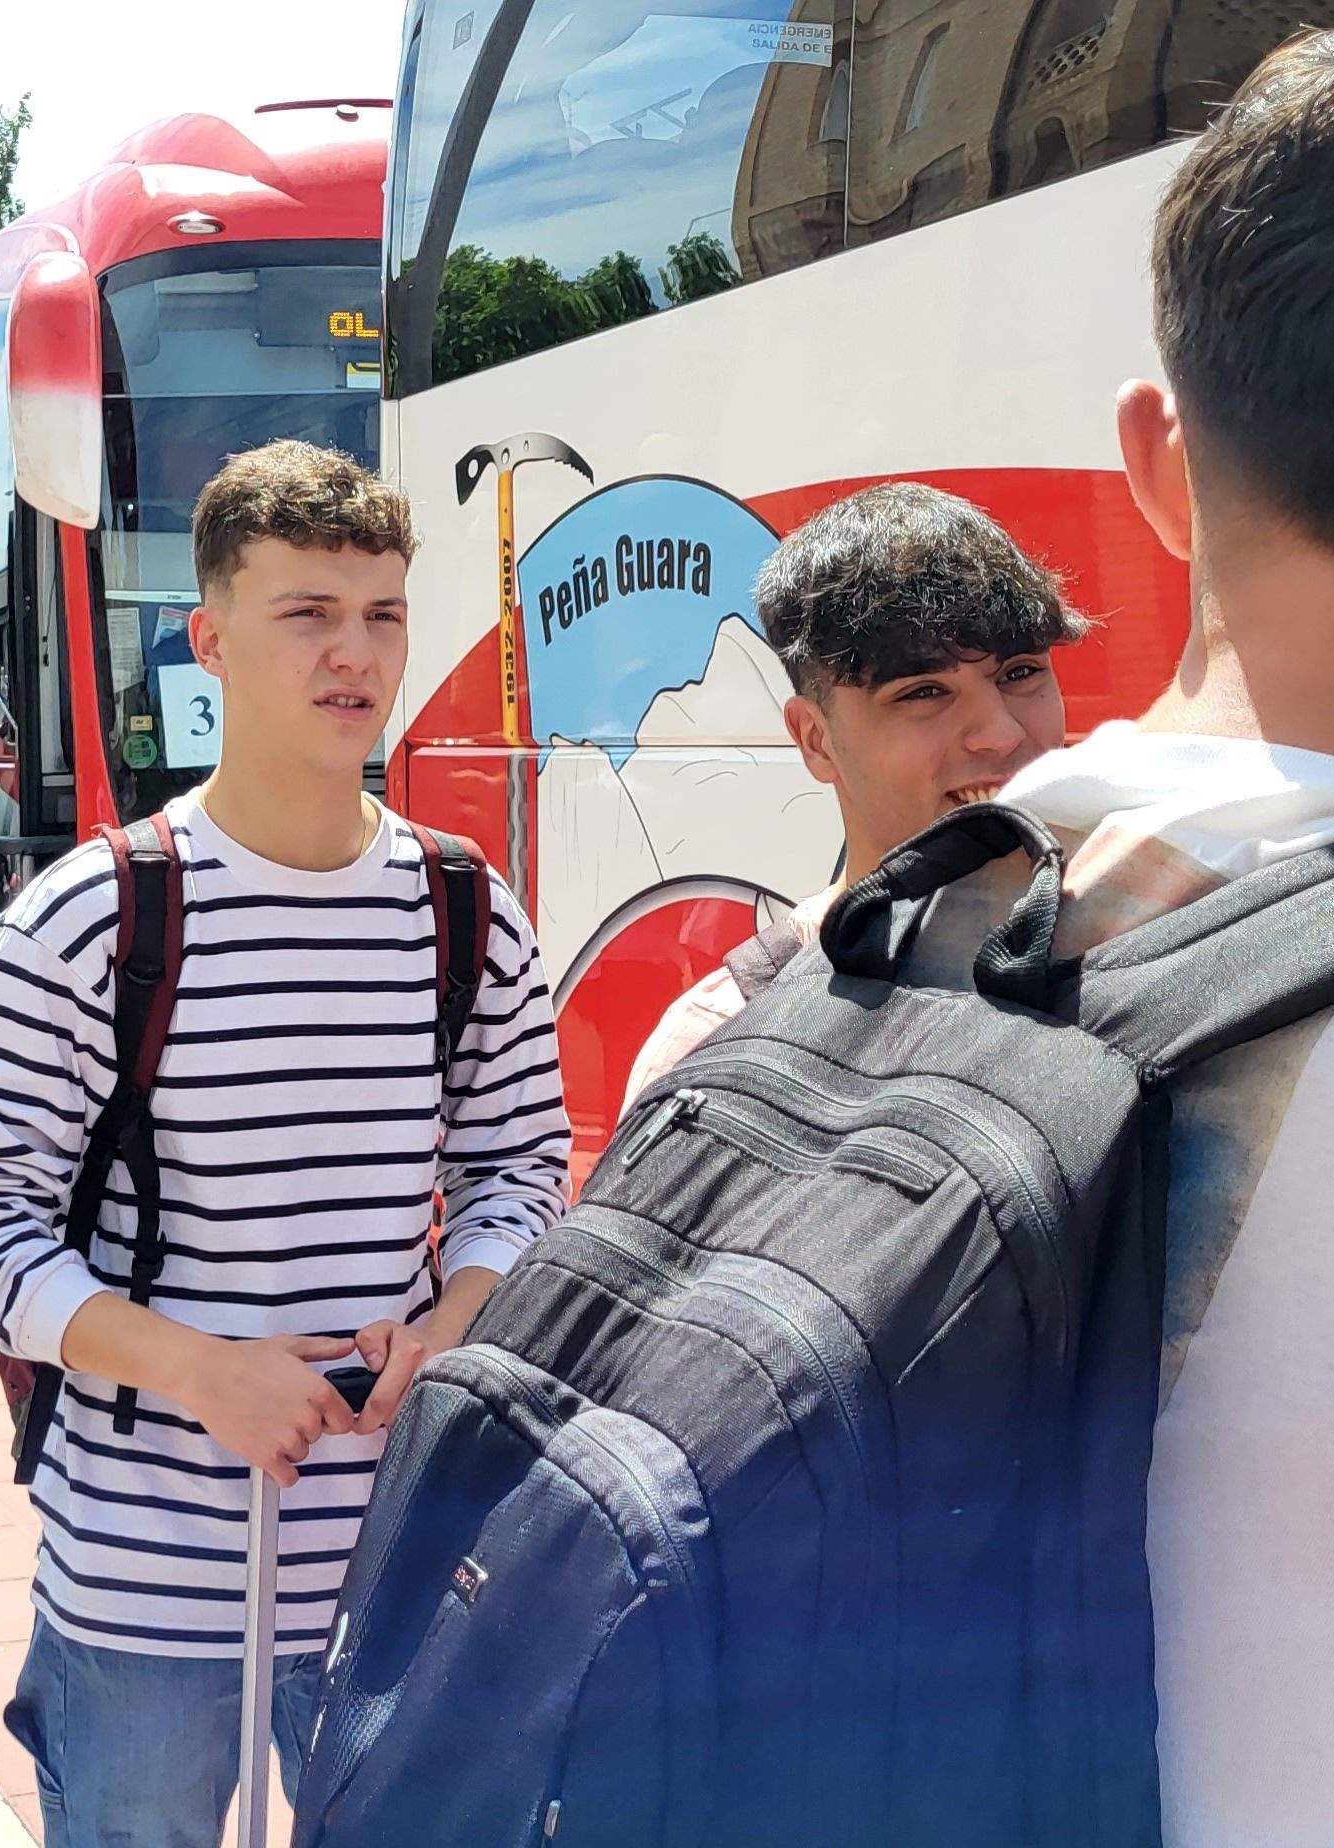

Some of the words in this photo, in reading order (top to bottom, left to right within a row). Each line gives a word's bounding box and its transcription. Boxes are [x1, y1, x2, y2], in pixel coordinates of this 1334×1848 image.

[752, 38, 799, 51] SALIDA
[802, 42, 820, 53] DE
[502, 538, 516, 704] 1932-2007
[539, 554, 609, 646] Peña
[616, 534, 711, 597] Guara
[189, 695, 215, 736] 3
